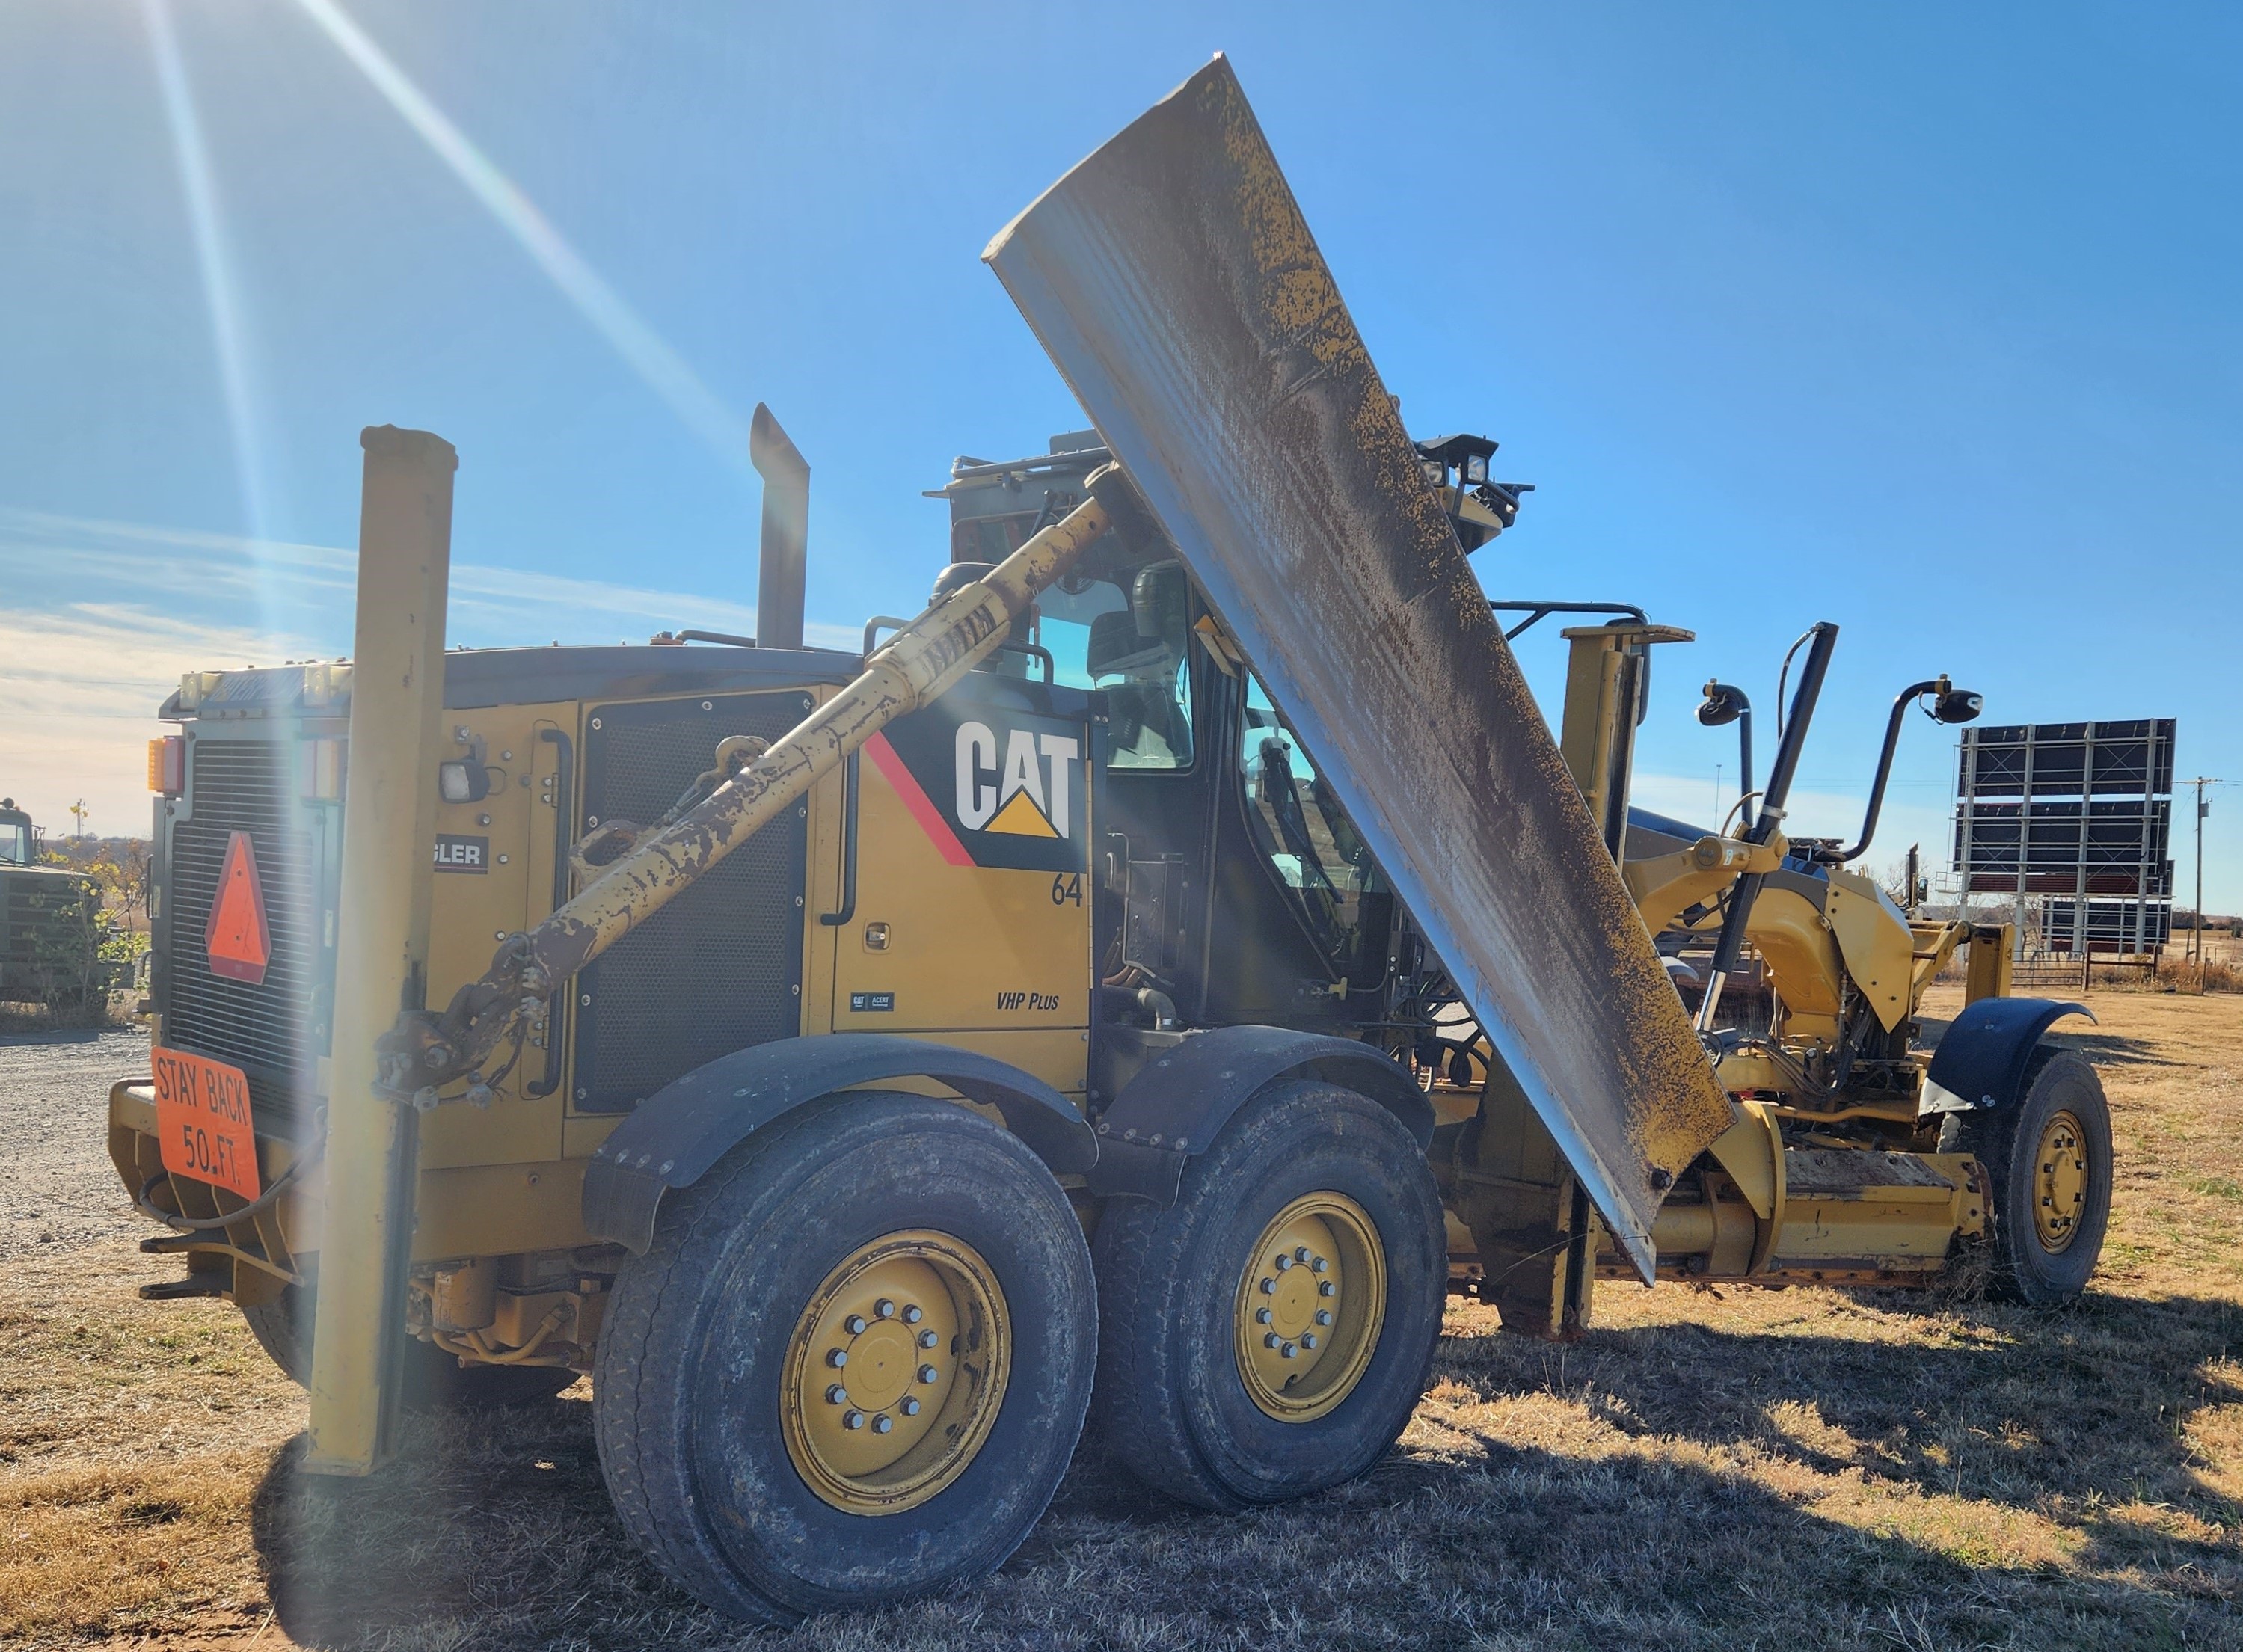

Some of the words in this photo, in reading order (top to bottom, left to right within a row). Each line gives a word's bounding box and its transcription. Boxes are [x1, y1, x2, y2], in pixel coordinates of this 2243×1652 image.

[956, 722, 1078, 839] CAT
[1052, 873, 1082, 907] 64
[998, 992, 1025, 1010] VHP
[158, 1057, 197, 1107] STAY
[205, 1069, 248, 1126] BACK
